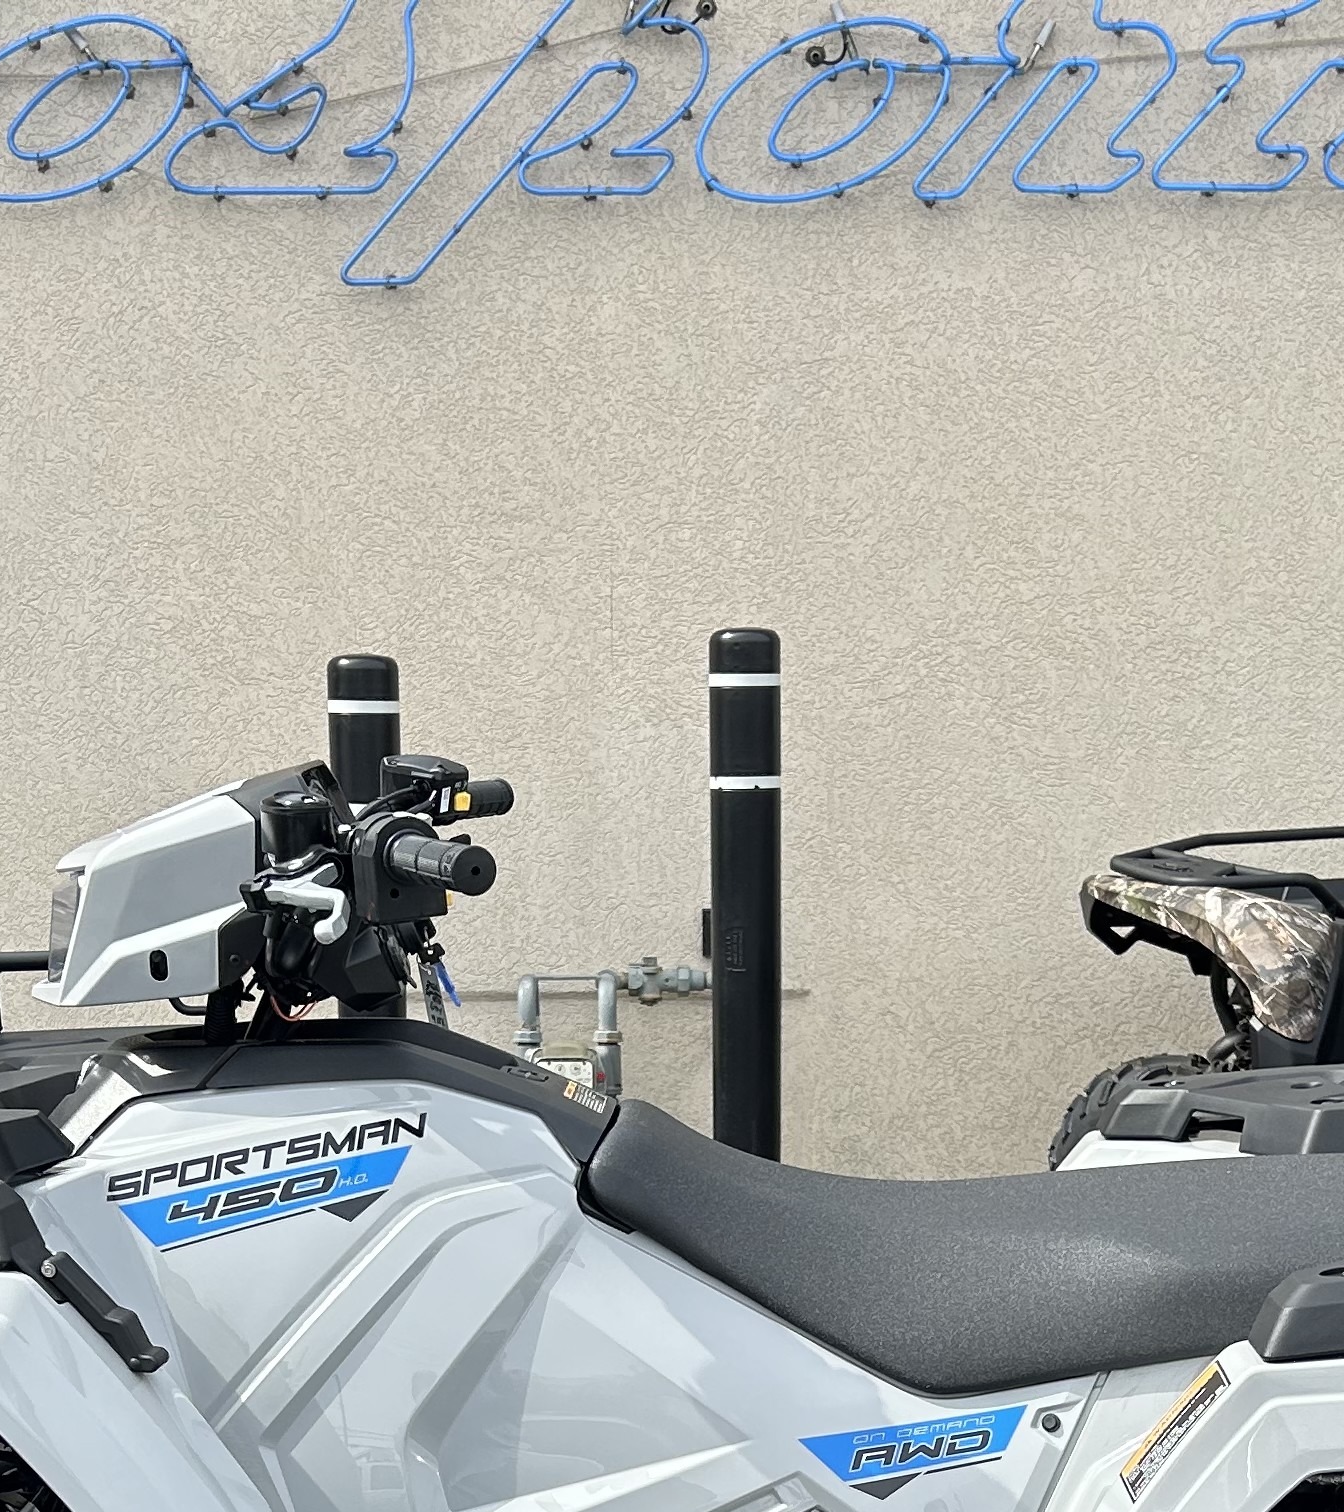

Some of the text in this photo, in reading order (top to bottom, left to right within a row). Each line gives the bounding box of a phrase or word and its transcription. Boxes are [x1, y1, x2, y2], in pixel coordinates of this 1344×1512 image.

[105, 1112, 428, 1202] SPORTSMAN
[166, 1167, 339, 1224] 450
[850, 1429, 992, 1473] AWD
[853, 1414, 996, 1445] ON DEMAND
